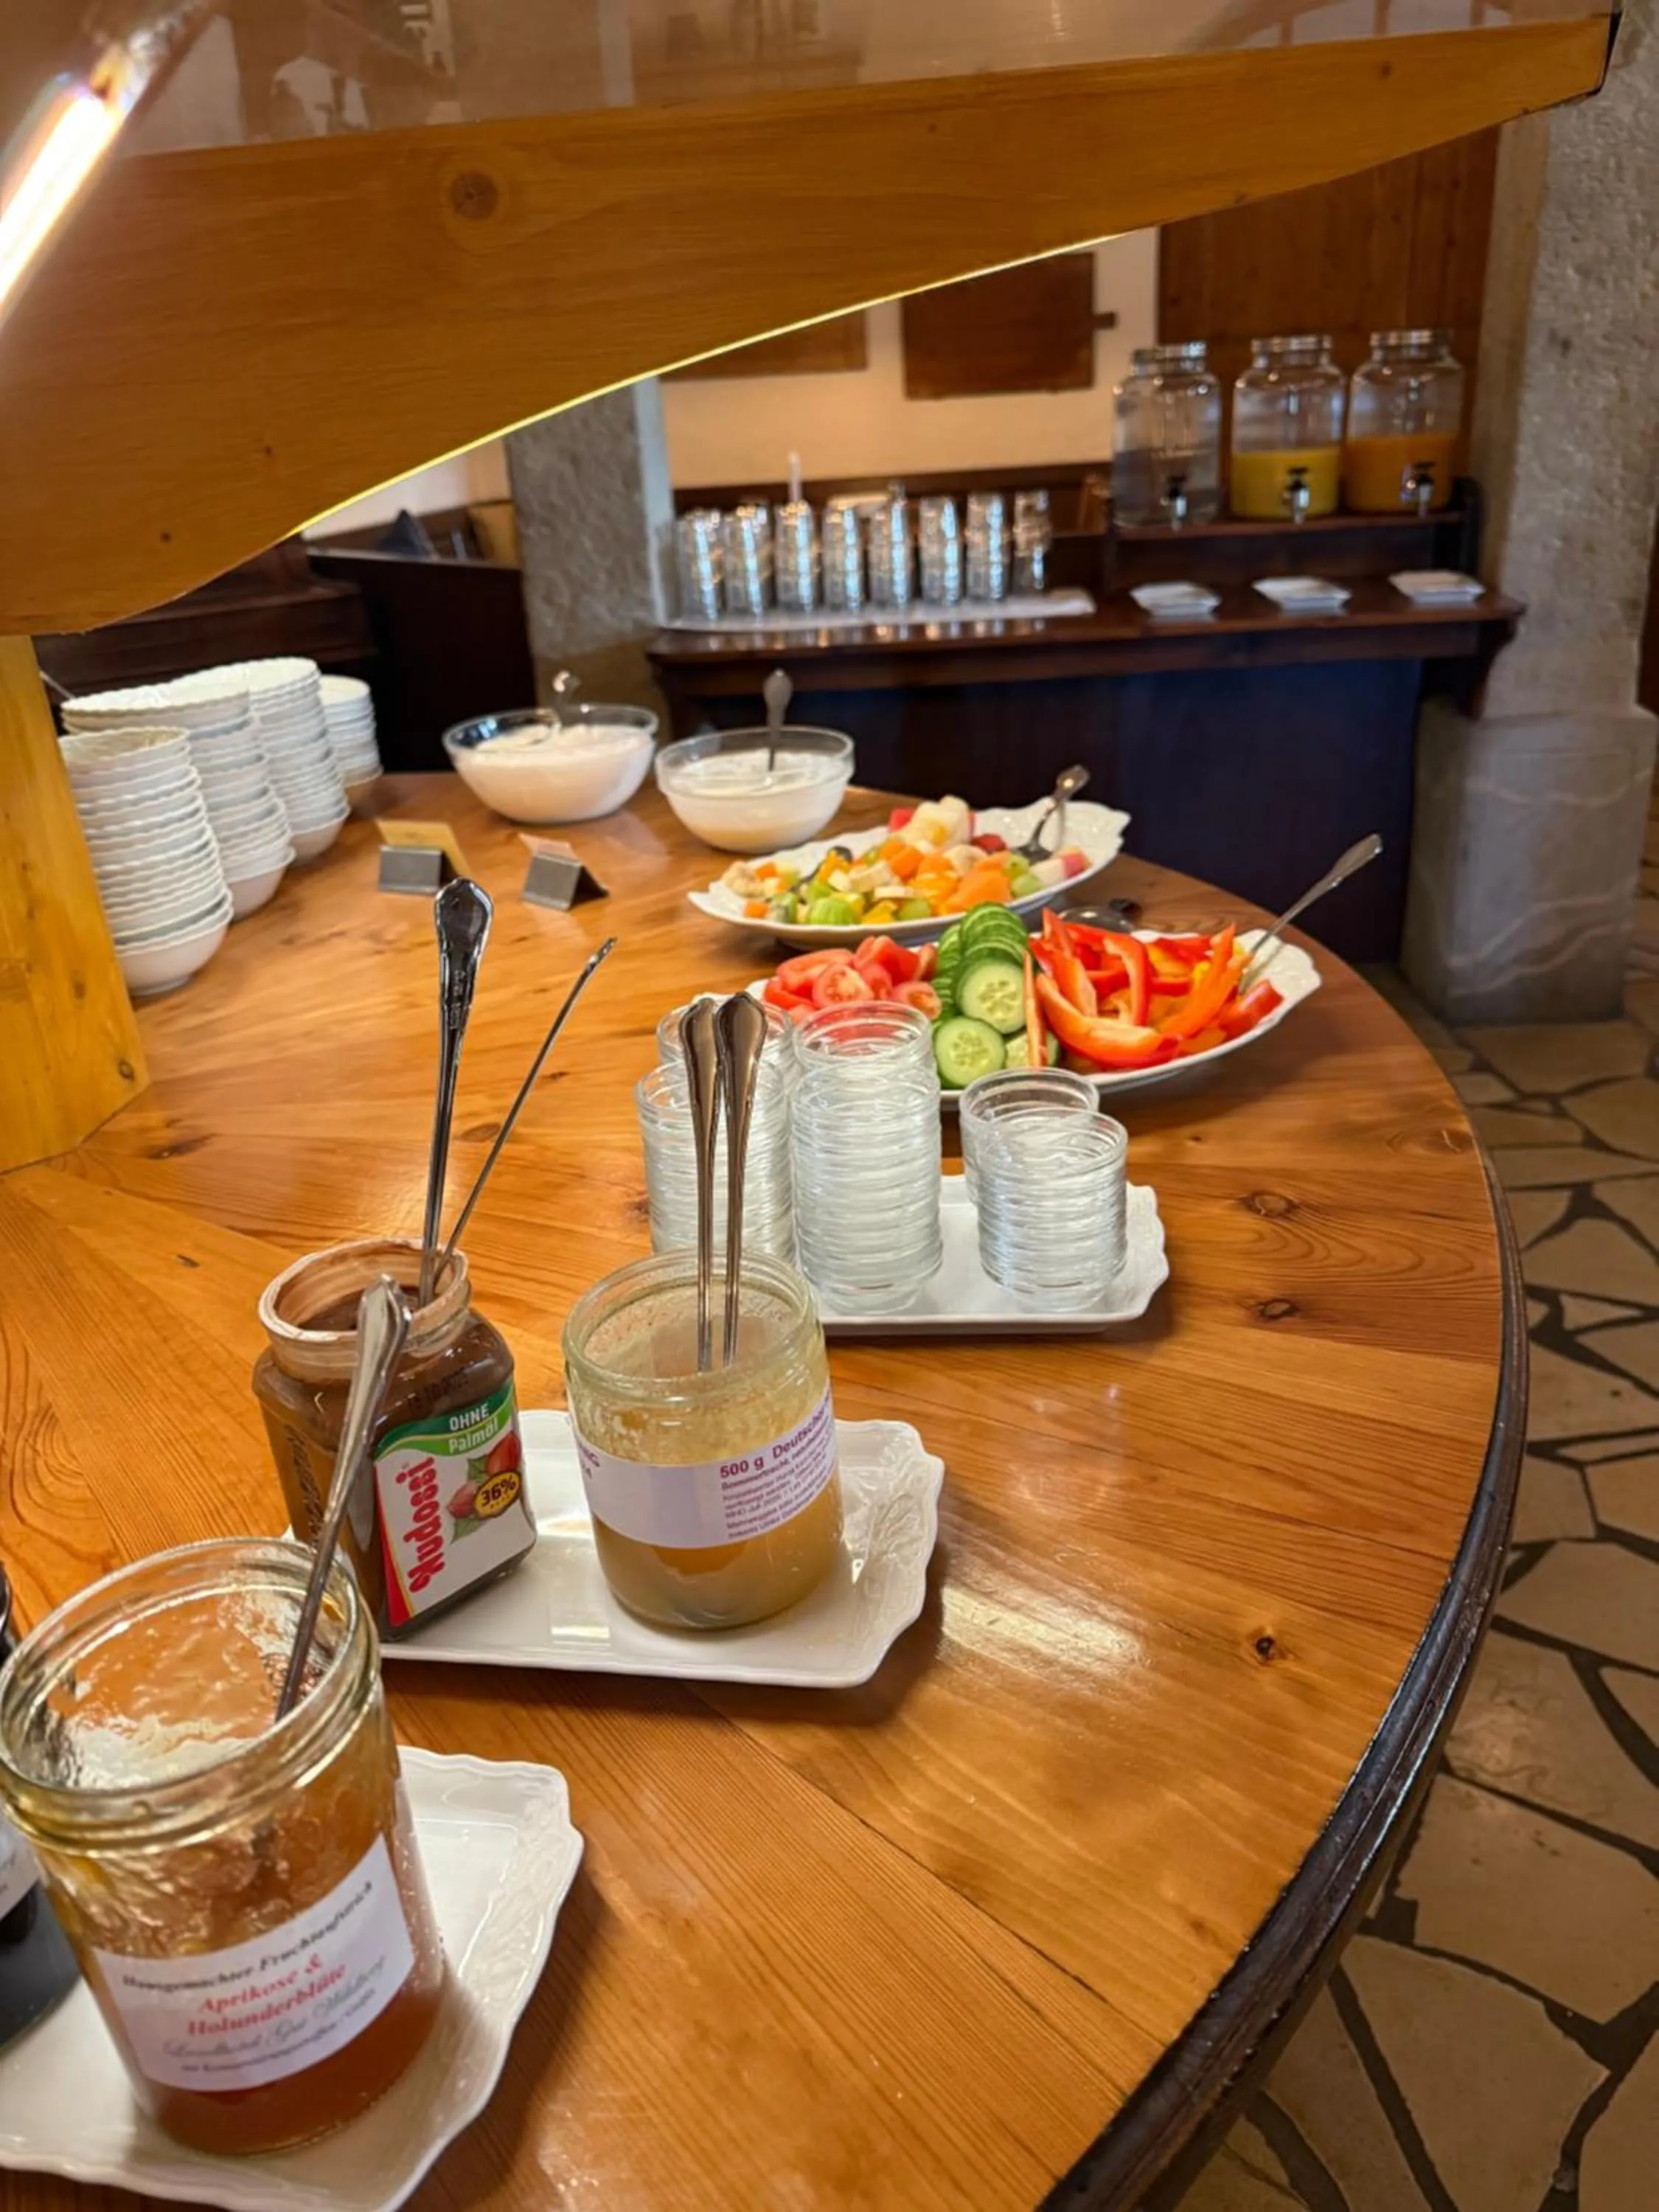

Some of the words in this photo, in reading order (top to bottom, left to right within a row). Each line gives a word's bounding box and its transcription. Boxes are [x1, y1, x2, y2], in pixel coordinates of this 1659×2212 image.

[449, 1403, 489, 1431] OHNE
[448, 1418, 498, 1454] Palmöl
[720, 1460, 749, 1478] 500
[754, 1455, 765, 1471] g
[481, 1474, 516, 1508] 36%
[396, 1456, 445, 1593] Nudossi
[199, 1969, 298, 2012] Aprikose
[305, 1952, 322, 1974] &
